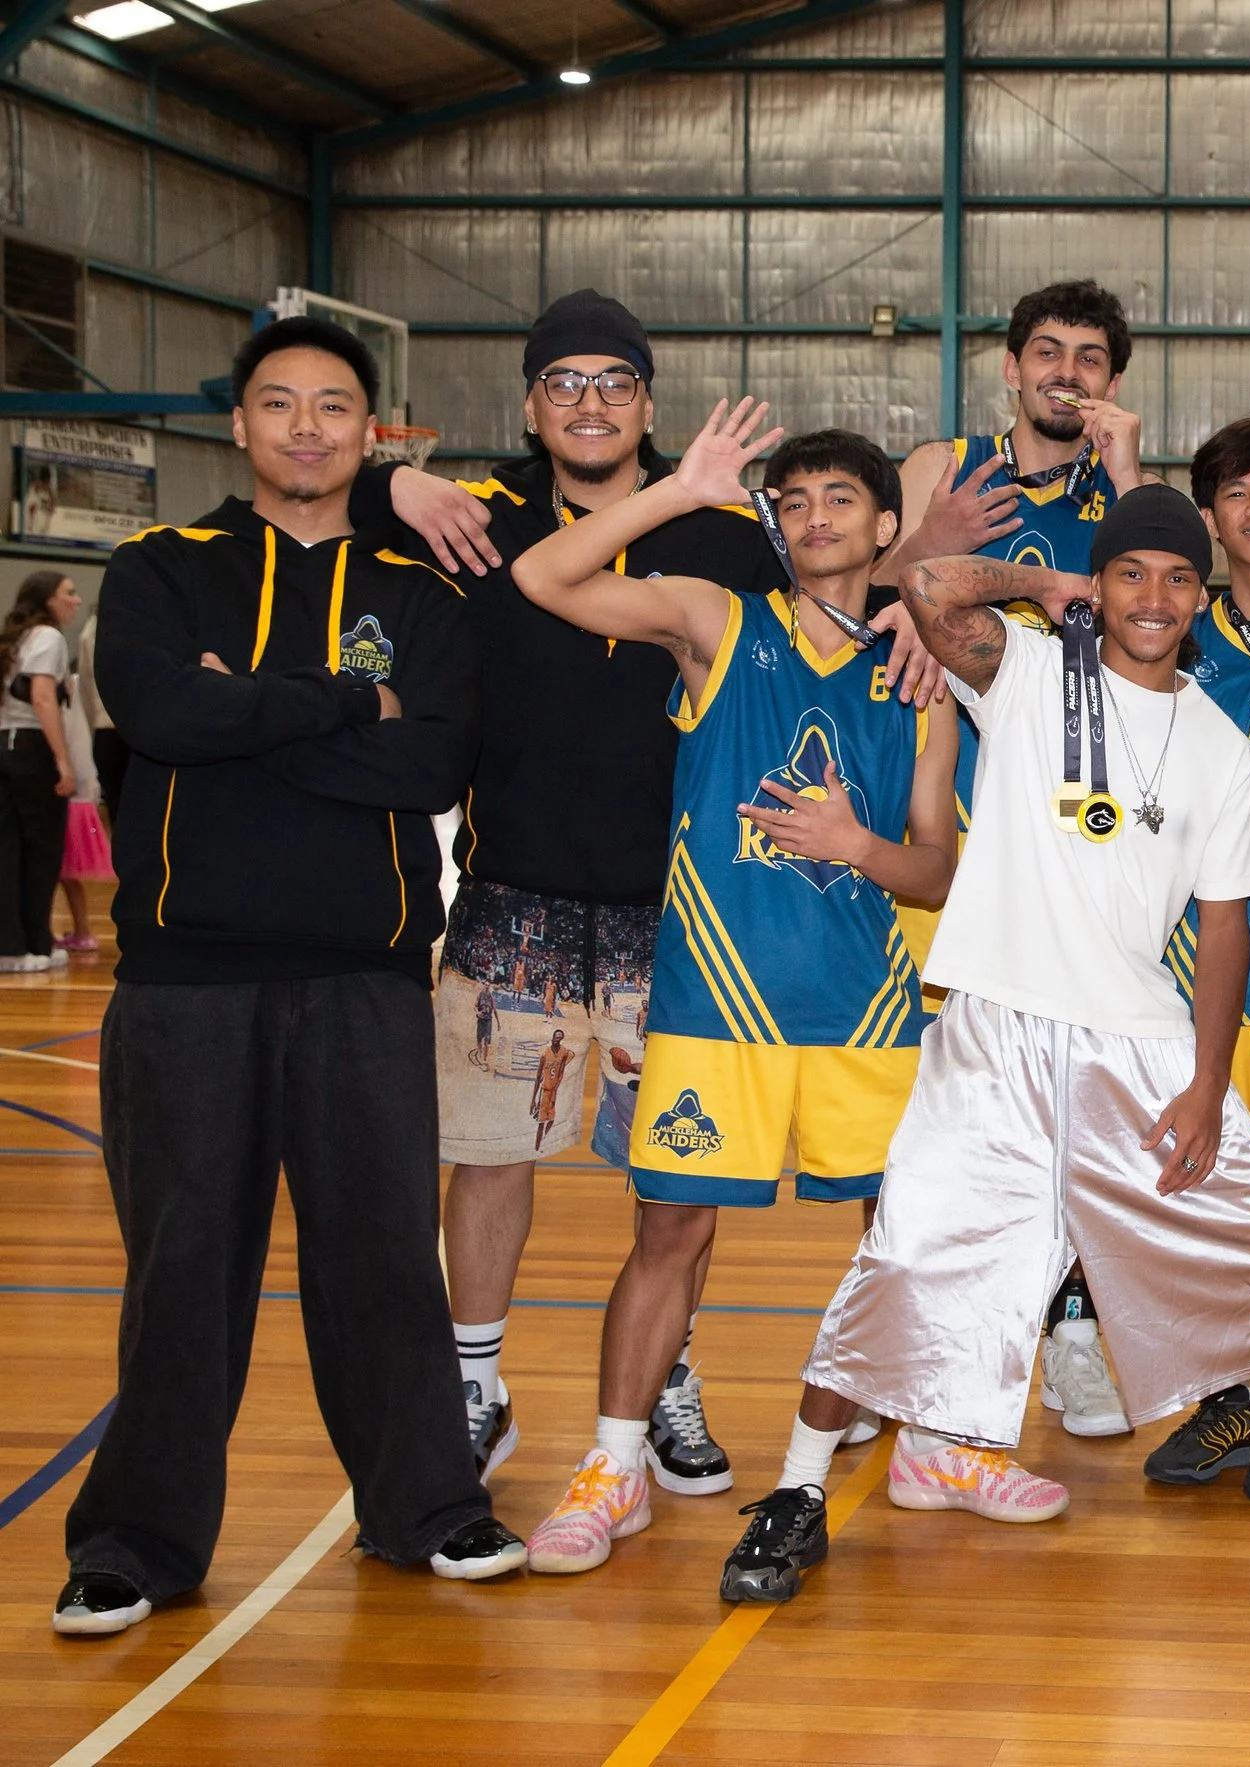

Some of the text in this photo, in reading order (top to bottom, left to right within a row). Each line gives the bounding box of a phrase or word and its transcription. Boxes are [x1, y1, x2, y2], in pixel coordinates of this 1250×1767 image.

[755, 491, 777, 529] PACERS
[1078, 490, 1106, 522] 15
[341, 647, 389, 660] MICKLEHAM
[341, 654, 392, 677] AIDERS
[1068, 670, 1076, 711] PACERS
[1089, 675, 1099, 717] PACERS
[647, 1128, 724, 1153] RAIDERS
[660, 1125, 712, 1137] MICKLEHAM
